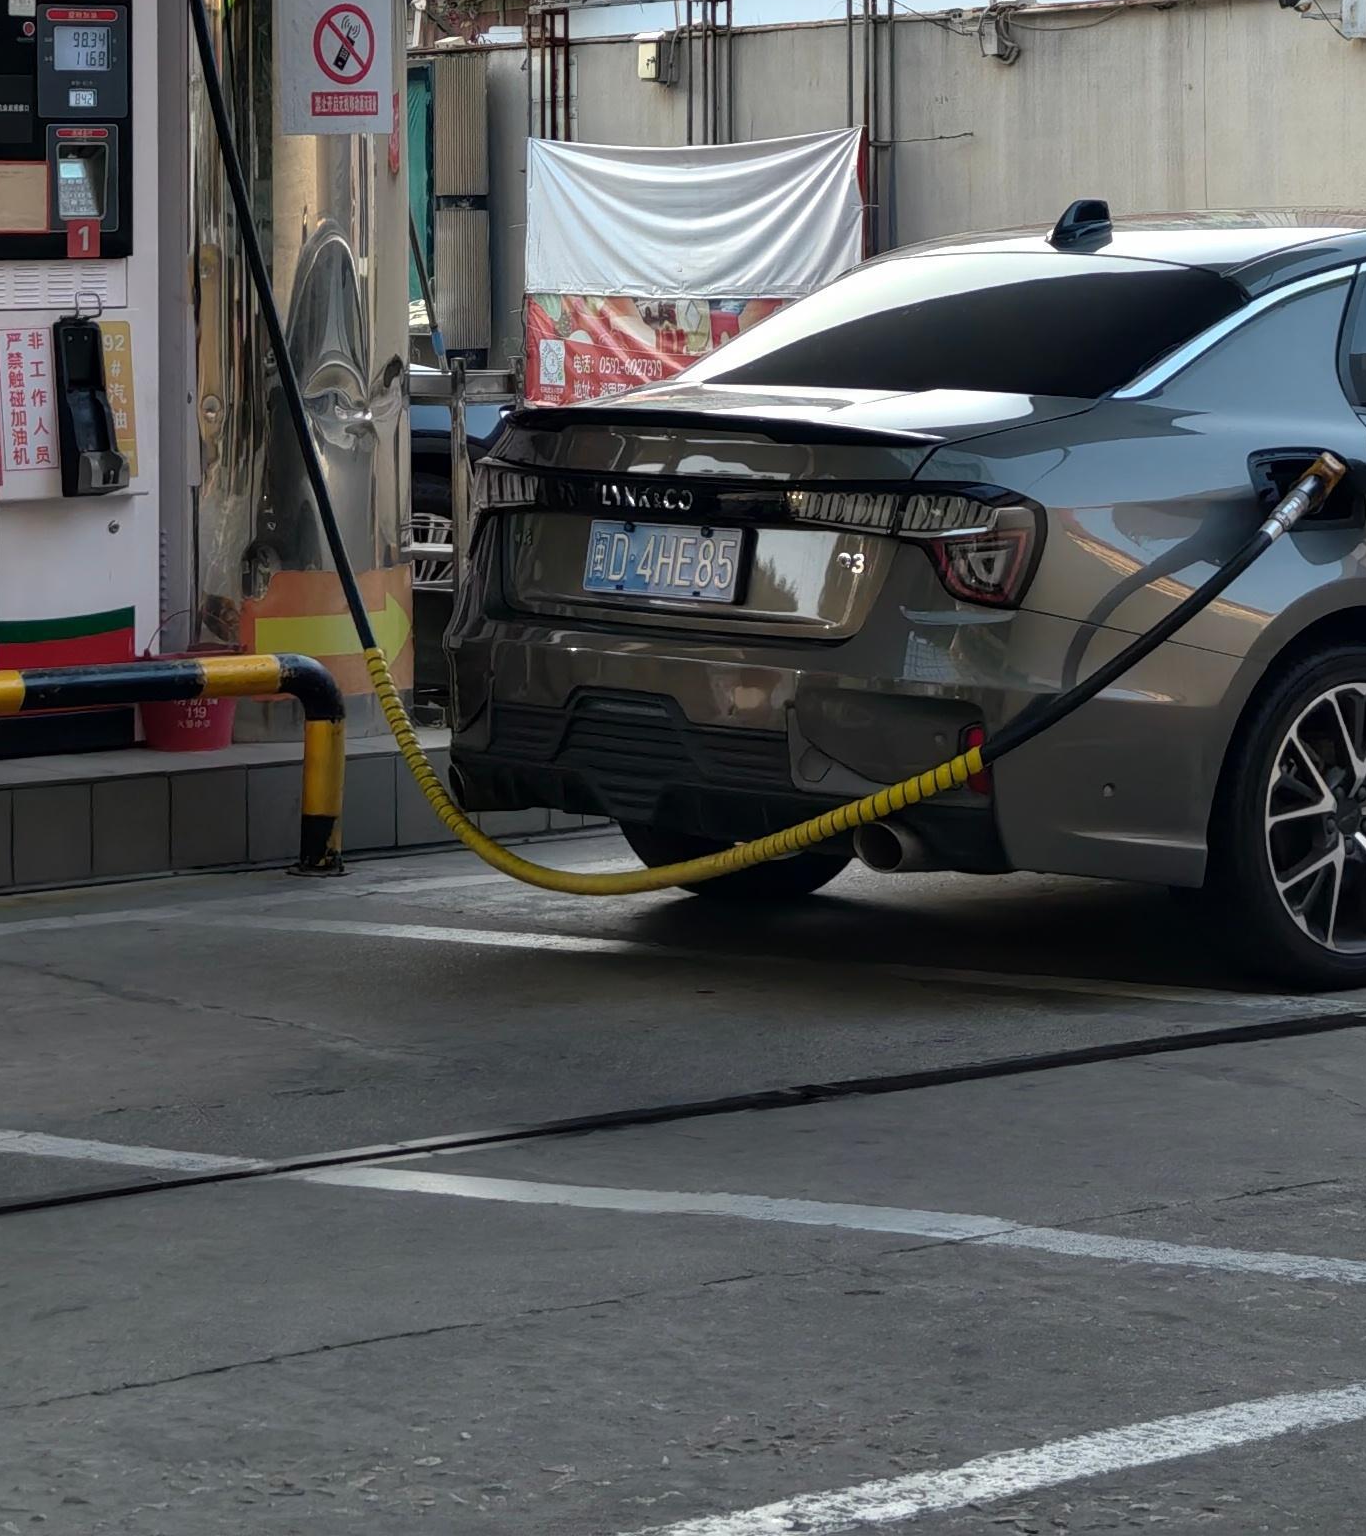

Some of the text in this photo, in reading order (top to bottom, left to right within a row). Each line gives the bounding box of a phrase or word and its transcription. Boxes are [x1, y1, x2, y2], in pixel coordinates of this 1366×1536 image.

[78, 226, 90, 252] 1
[6, 332, 30, 465] 严禁触碰加油机
[27, 331, 51, 464] 非工作人员
[187, 707, 207, 719] 119
